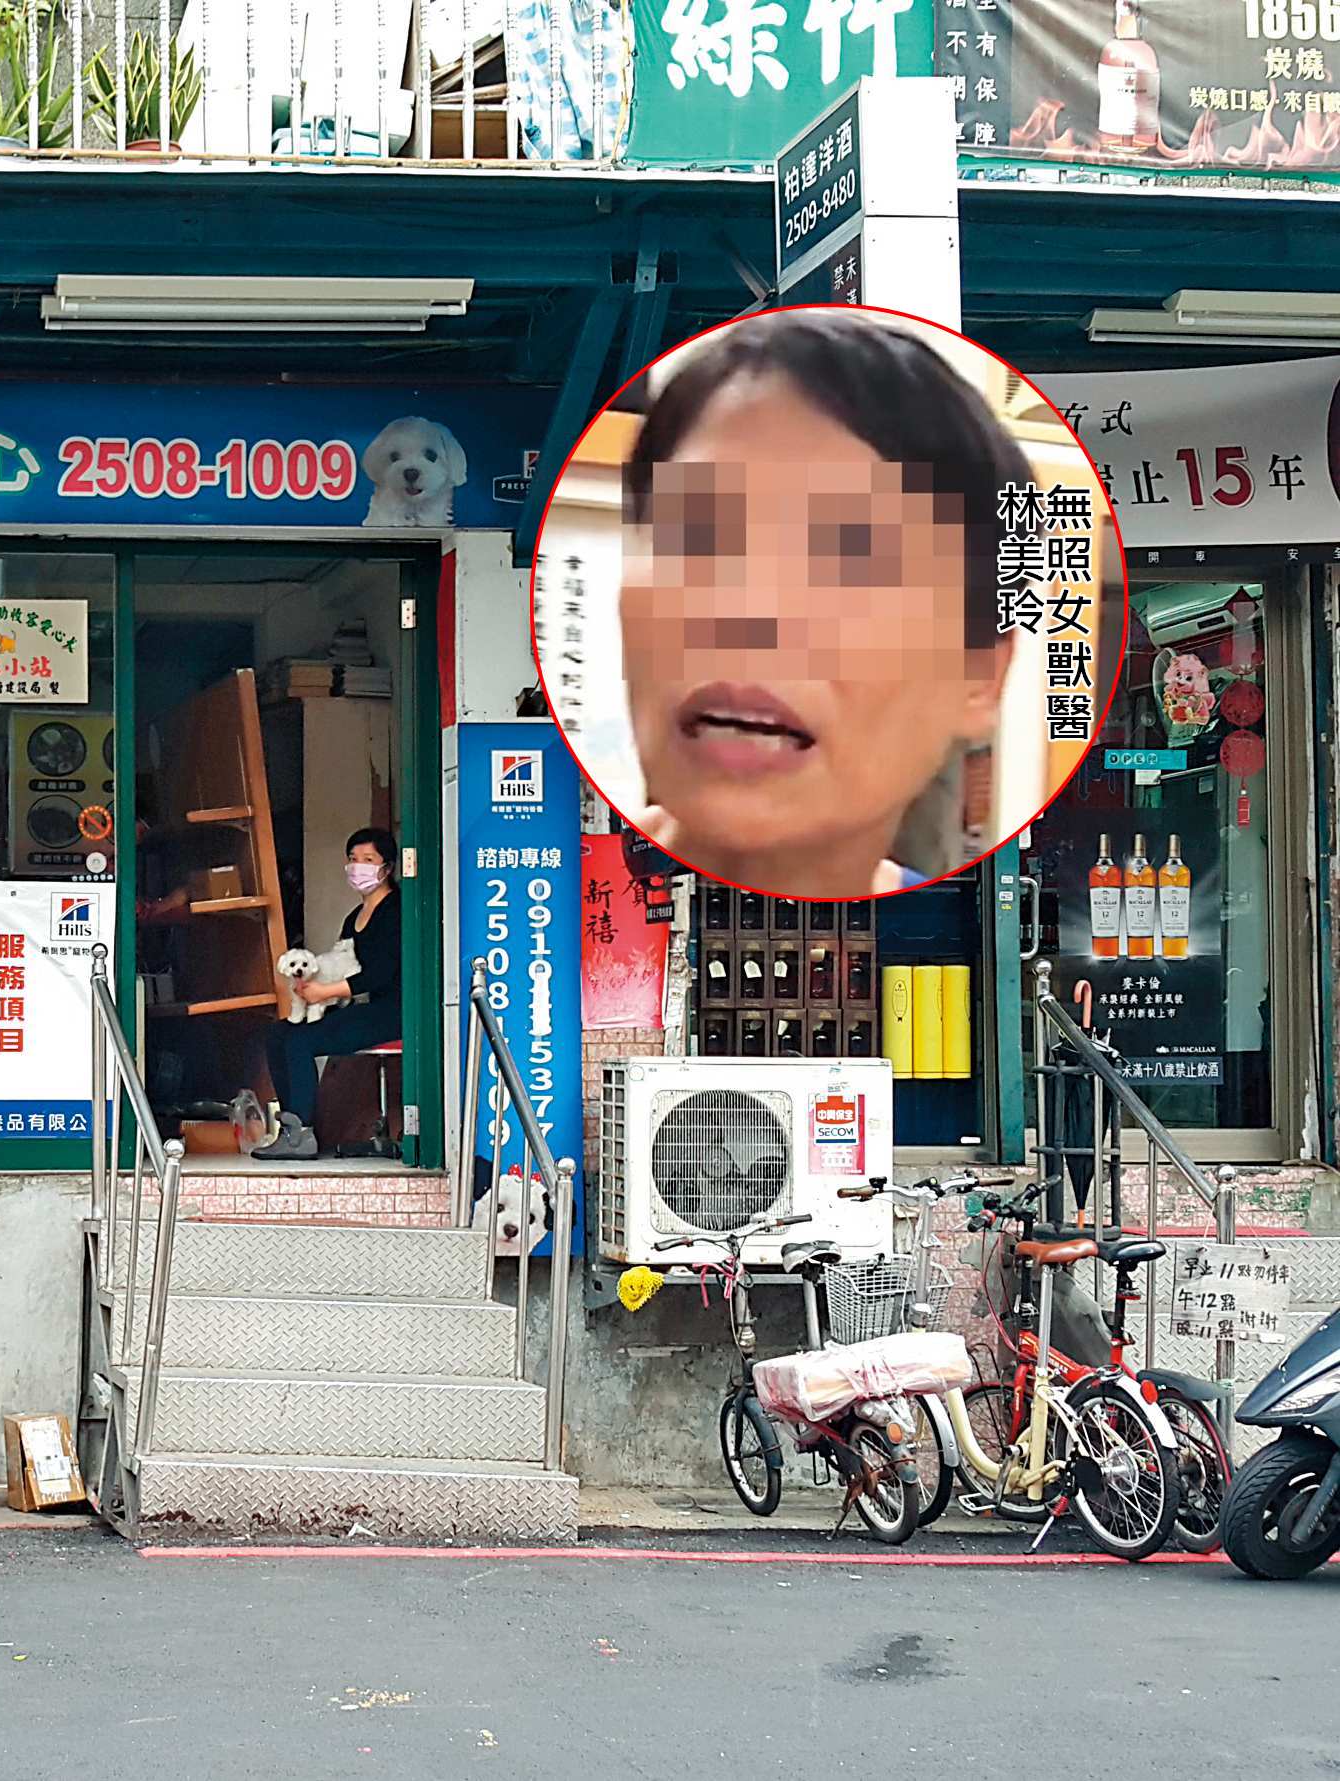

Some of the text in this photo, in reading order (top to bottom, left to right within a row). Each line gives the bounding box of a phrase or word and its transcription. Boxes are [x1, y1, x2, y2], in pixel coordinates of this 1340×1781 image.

[1264, 46, 1325, 81] 炭燒
[783, 117, 853, 205] 柏達洋酒
[785, 168, 856, 249] 2509-8480
[57, 436, 357, 500] 2508-1009
[500, 783, 535, 796] Hill's
[477, 848, 561, 869] 諮詢專線
[58, 922, 92, 936] Hill's
[1122, 977, 1160, 990] 麥卡倫
[818, 1127, 854, 1137] SECOM
